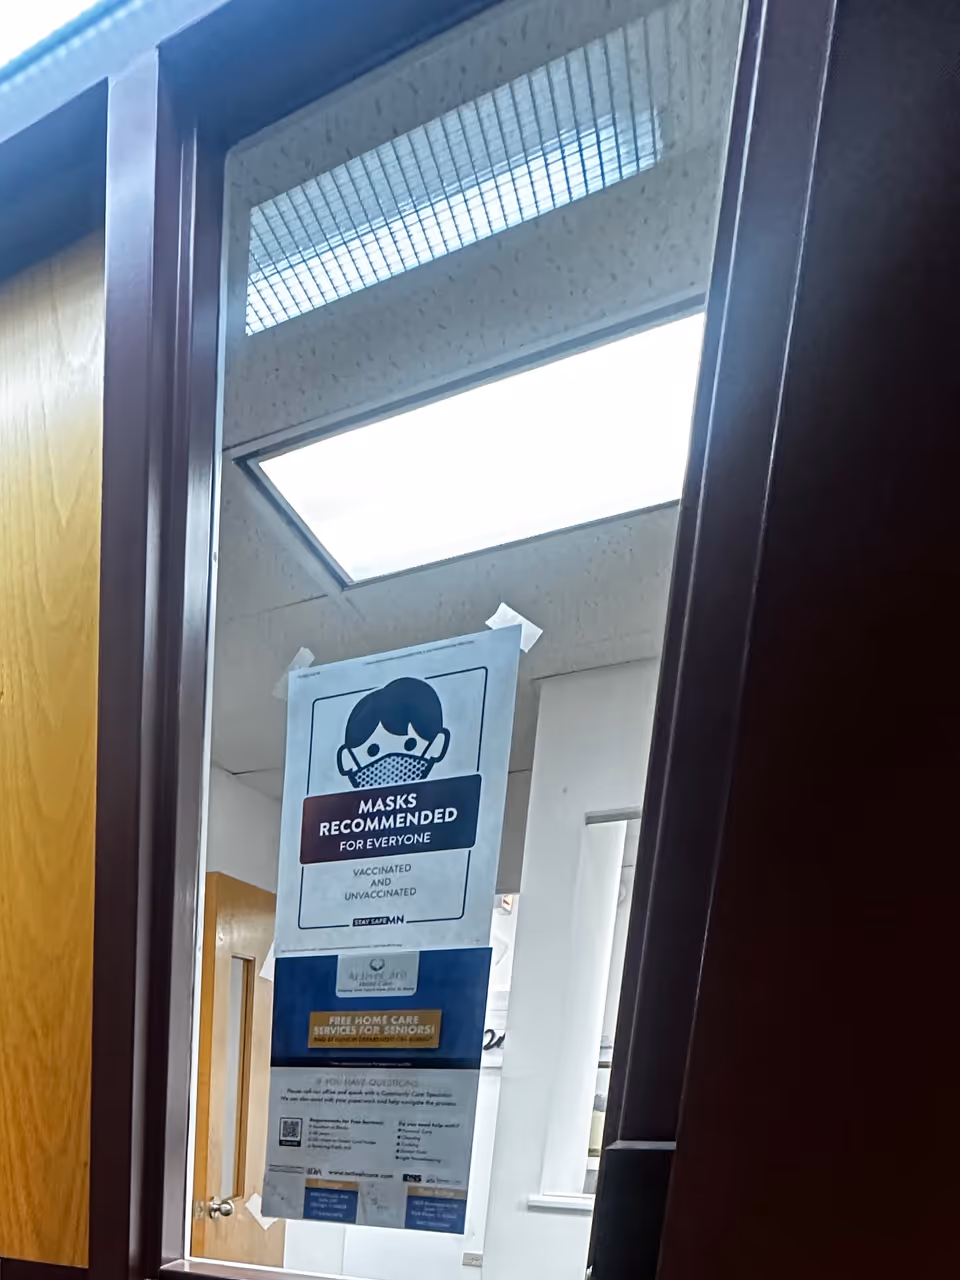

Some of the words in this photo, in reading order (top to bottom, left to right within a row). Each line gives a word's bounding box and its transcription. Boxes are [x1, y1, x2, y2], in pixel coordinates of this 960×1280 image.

[358, 793, 417, 815] MASKS
[319, 807, 458, 836] RECOMMENDED
[339, 839, 364, 852] FOR
[366, 832, 431, 849] EVERYONE
[353, 863, 412, 877] VACCINATED
[370, 878, 392, 887] AND
[344, 887, 417, 901] UNVACCINATED
[329, 1015, 352, 1025] FREE
[355, 1015, 388, 1025] HOME
[391, 1014, 419, 1025] CARE
[313, 1025, 356, 1036] SERVICES
[359, 1025, 380, 1035] FOR
[384, 1024, 435, 1035] SENIORS!
